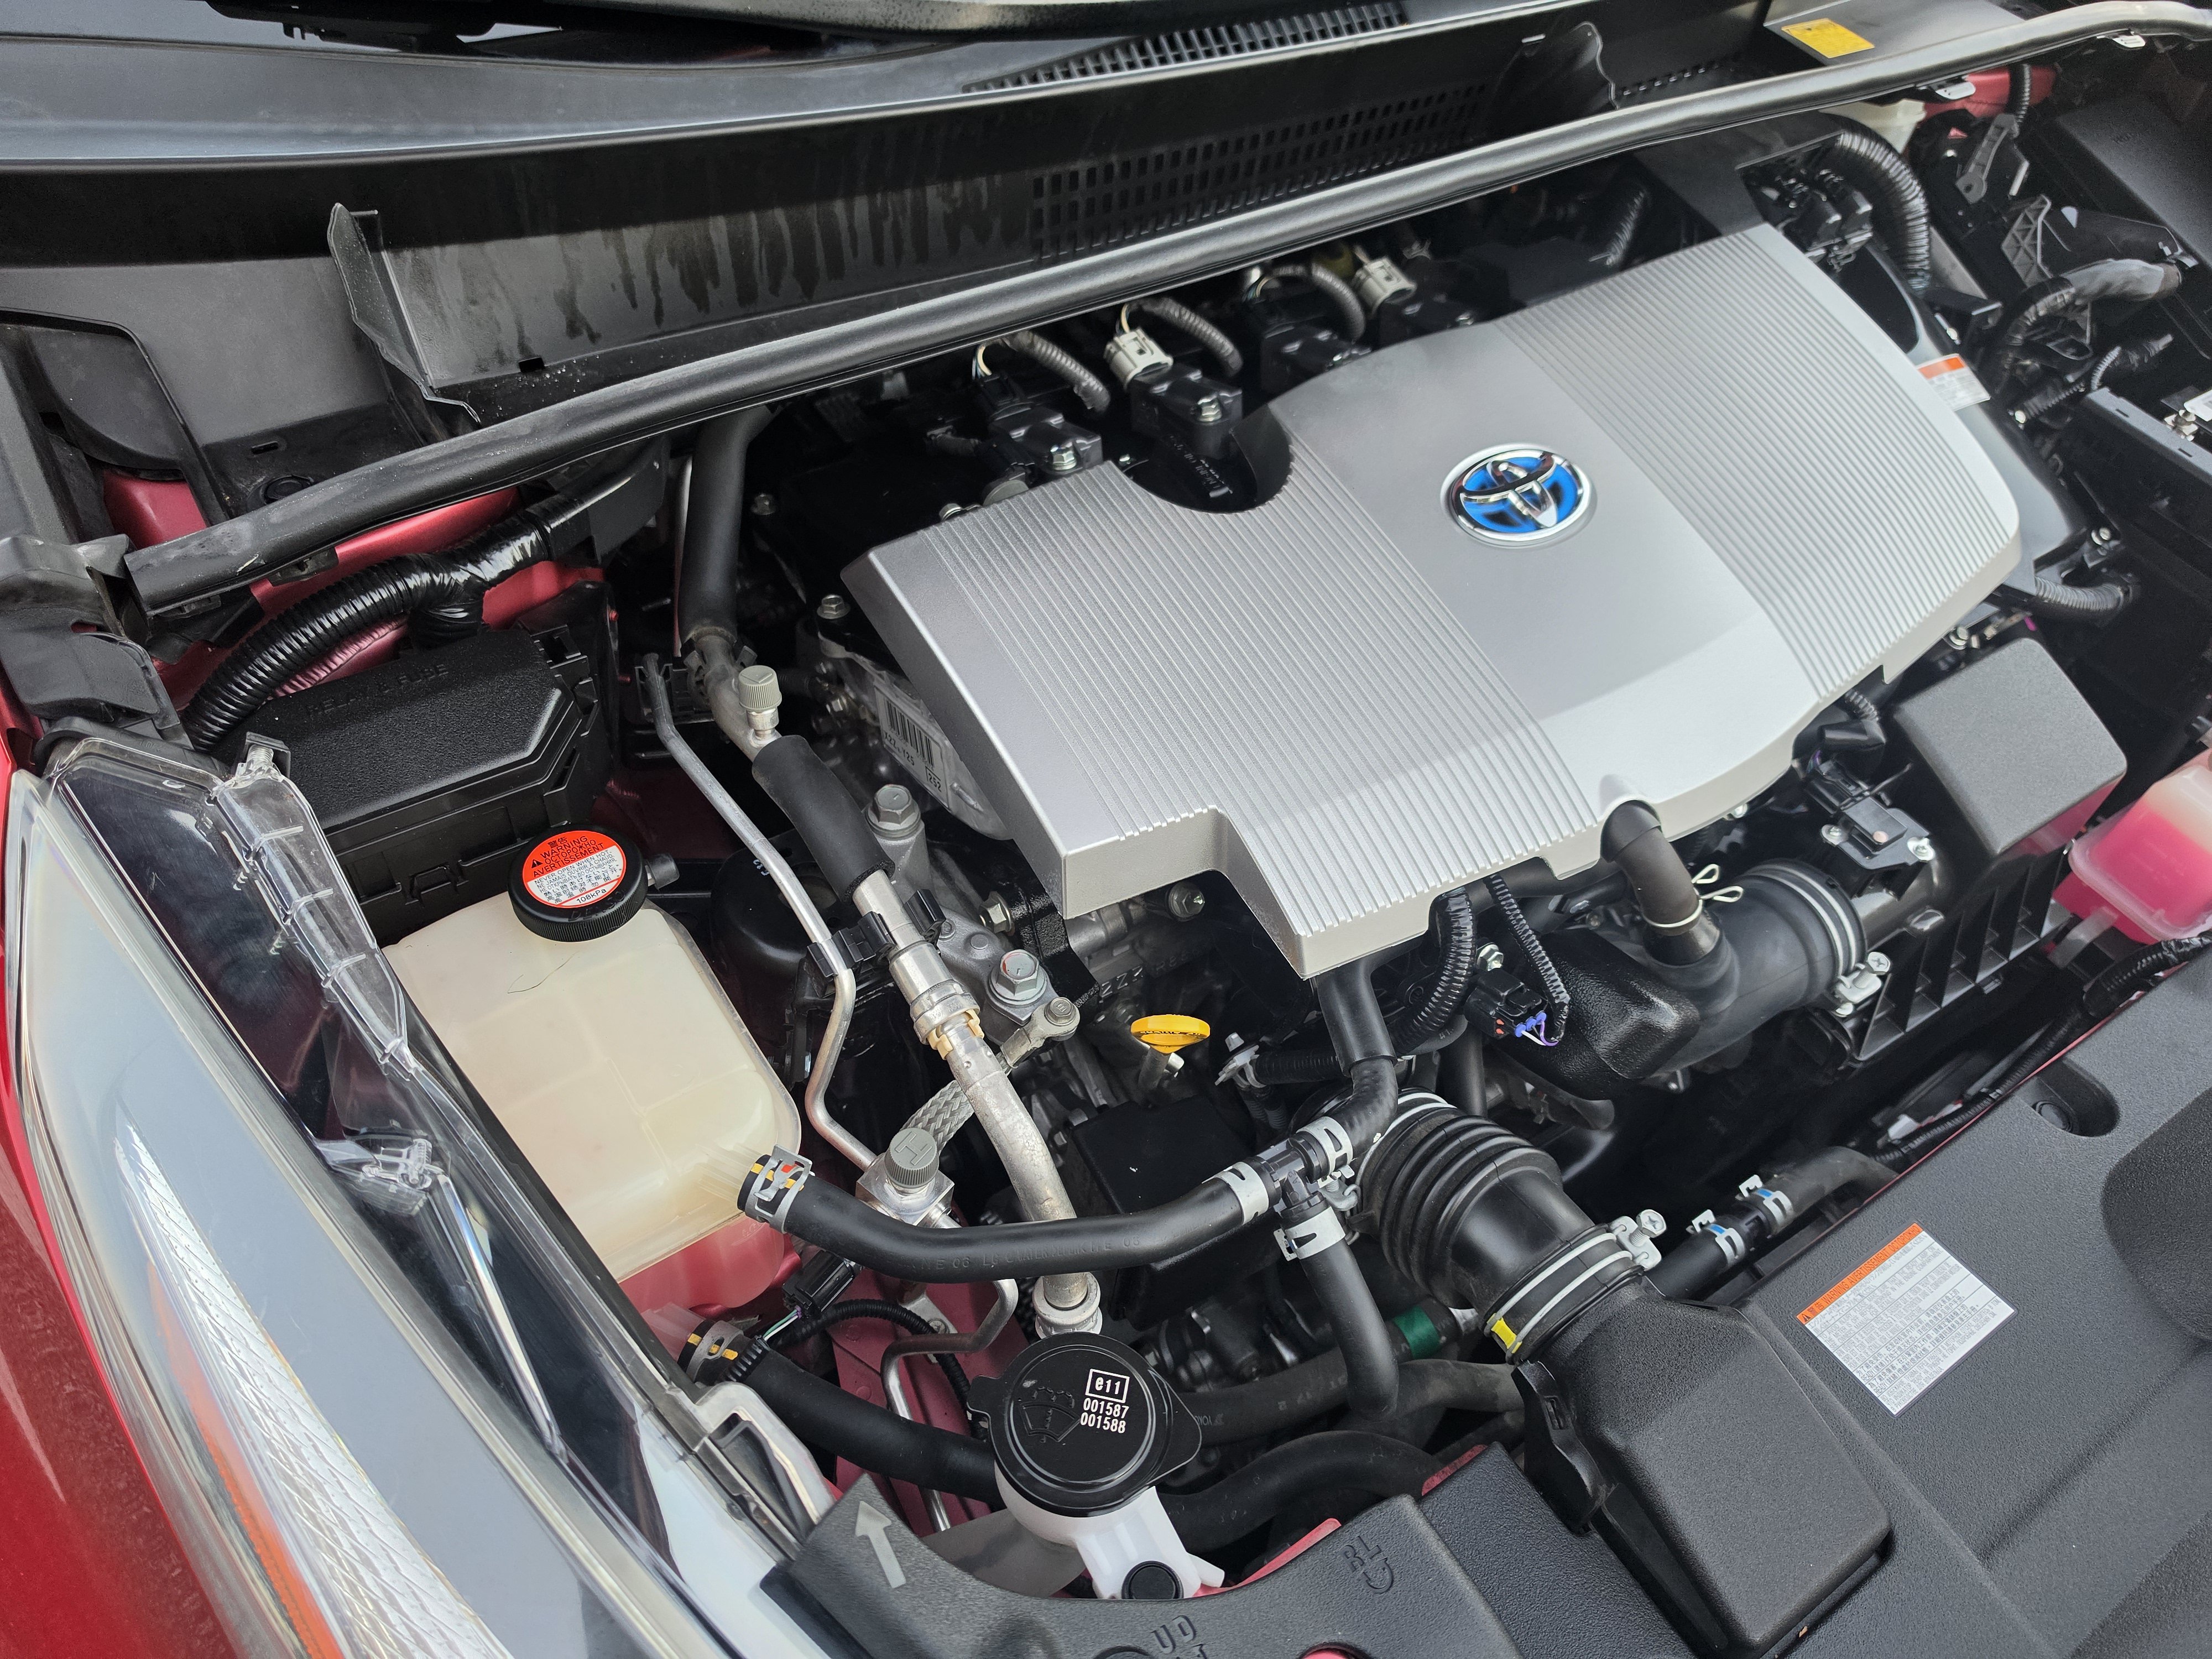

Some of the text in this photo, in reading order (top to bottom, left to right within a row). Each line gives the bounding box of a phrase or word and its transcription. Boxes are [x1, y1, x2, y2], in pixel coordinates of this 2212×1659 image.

[928, 773, 942, 792] 252
[540, 836, 588, 859] WARNING
[545, 839, 596, 864] ОСТОРОЖНО
[547, 836, 568, 848] 警告
[534, 842, 604, 878] AVERTISSEMENT
[535, 849, 612, 884] NEVER OPEN WHEN HOT.
[546, 874, 567, 885] JAMAIS
[567, 865, 587, 876] OUVRIR
[594, 854, 615, 865] CHAUD.
[548, 875, 577, 890] ОТКРЫВАТЬ
[585, 858, 618, 874] ОСТЫВАНИЯ.
[576, 888, 607, 904] 108kPa
[895, 1131, 932, 1165] H
[1821, 1280, 1850, 1305] WARNING
[1846, 1249, 1891, 1285] AVERTISSEMENT
[1888, 1226, 1919, 1251] ОСТОРОЖНО
[1095, 1377, 1120, 1395] e11
[1083, 1398, 1129, 1419] 001587
[1080, 1412, 1126, 1433] 001588
